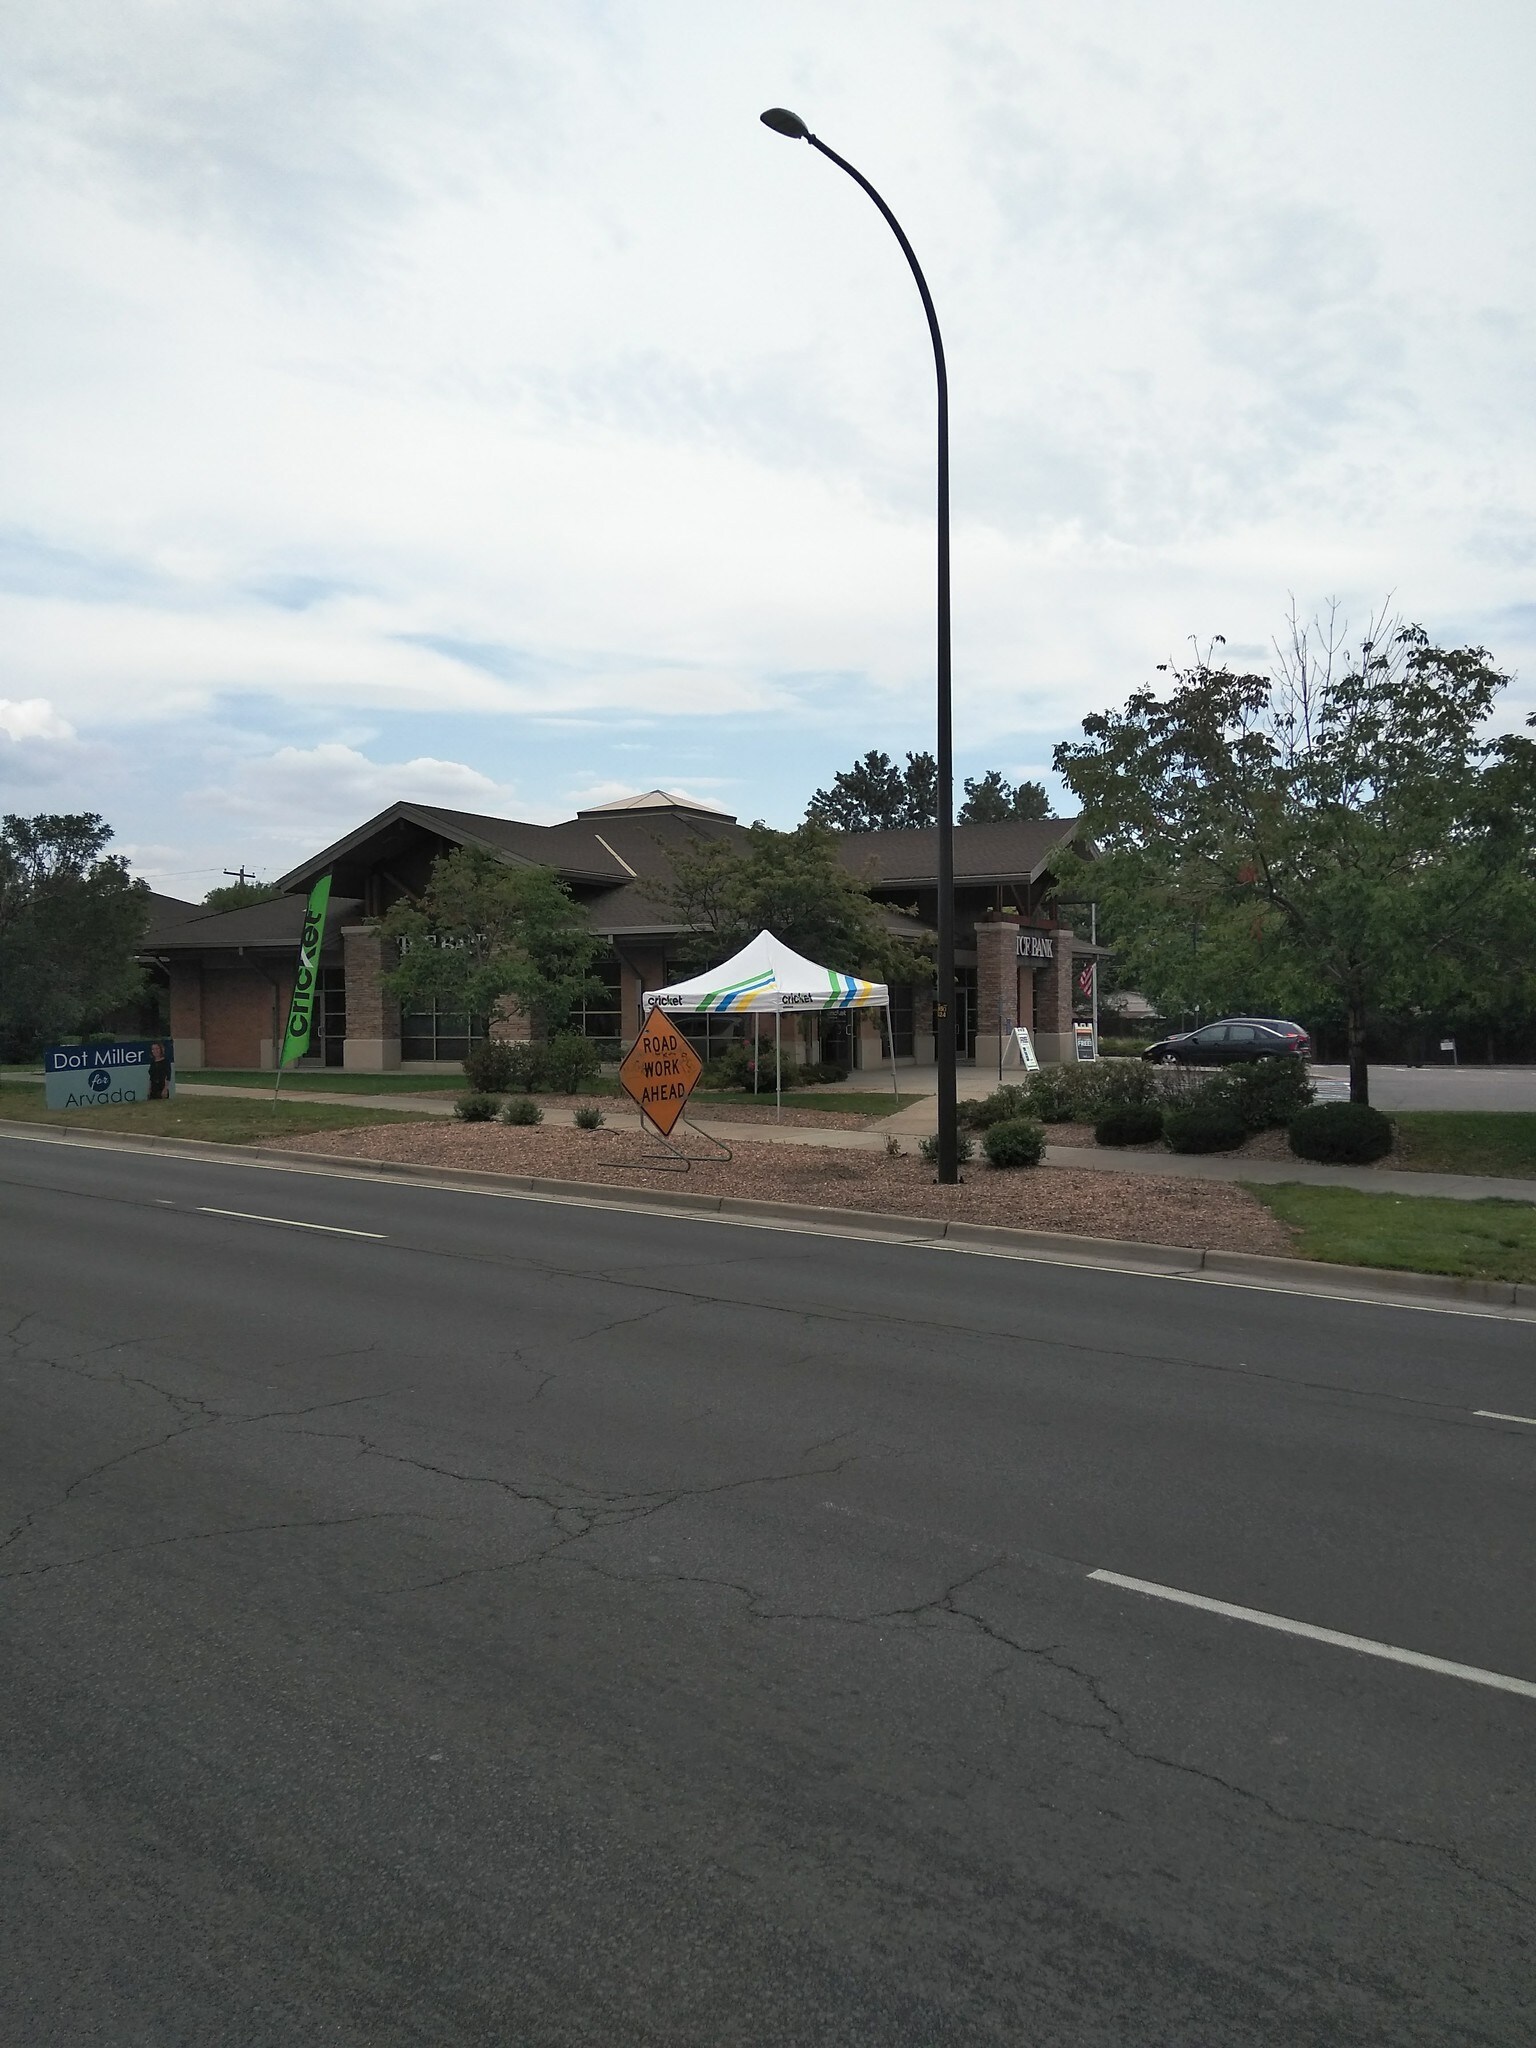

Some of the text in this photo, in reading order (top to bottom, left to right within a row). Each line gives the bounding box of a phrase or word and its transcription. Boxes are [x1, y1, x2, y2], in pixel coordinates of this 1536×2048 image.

[1031, 936, 1054, 958] BANK
[289, 911, 322, 1037] cricket
[647, 994, 683, 1006] cricket
[782, 992, 814, 1005] cricket
[643, 1035, 678, 1054] ROAD
[53, 1048, 145, 1069] Dot Miller
[643, 1059, 680, 1078] WORK
[89, 1073, 108, 1090] for
[65, 1088, 136, 1108] Arvada
[641, 1083, 686, 1103] AHEAD
